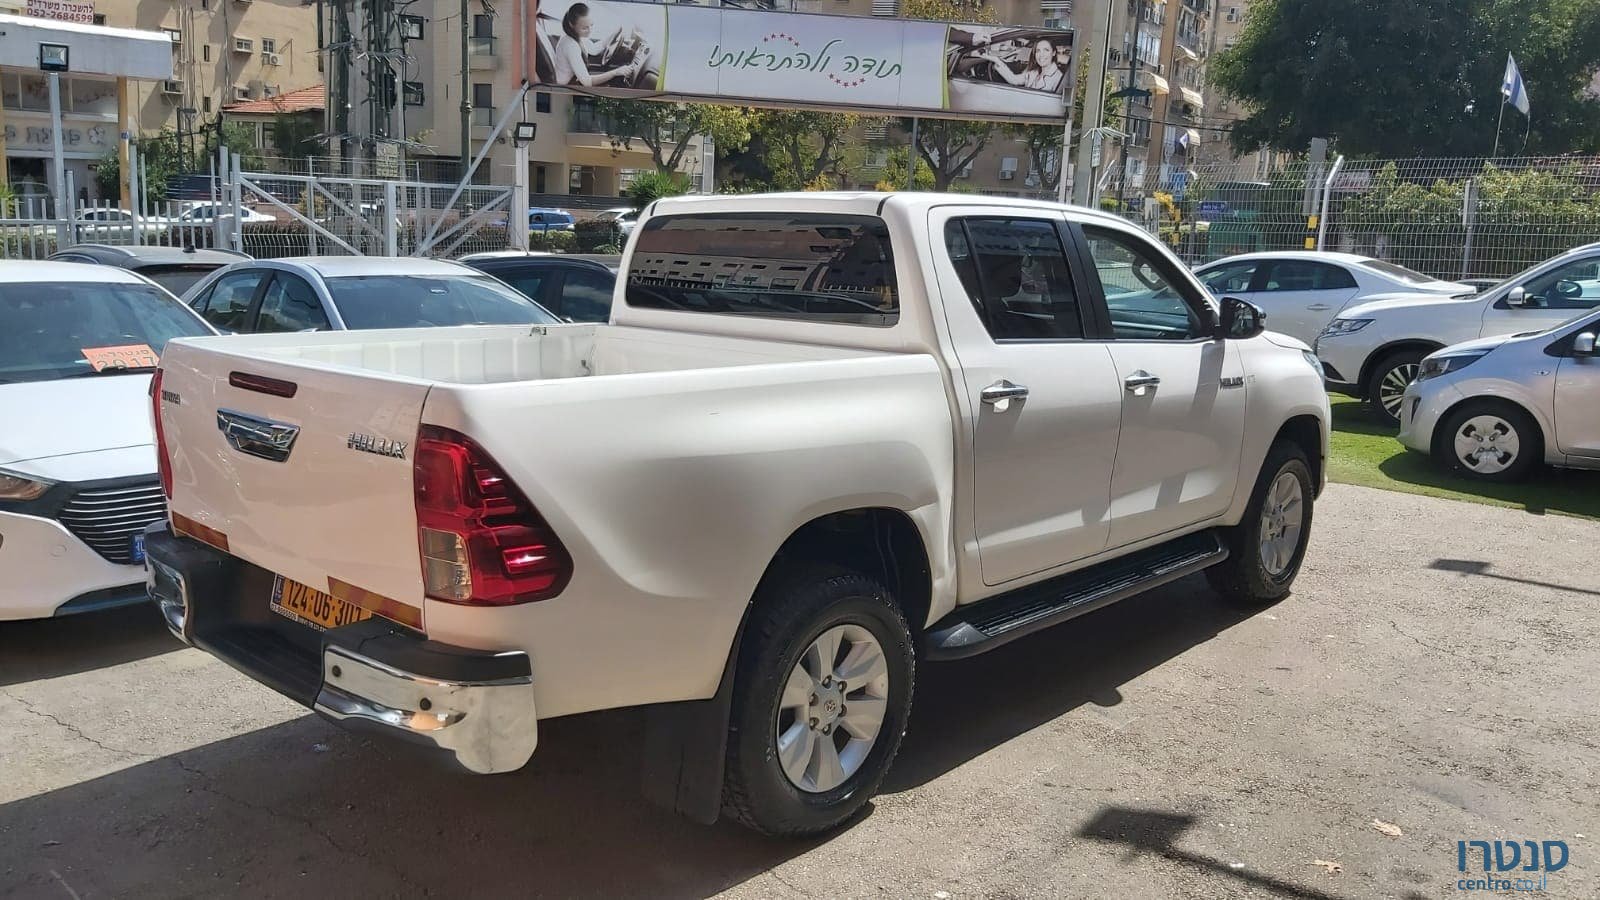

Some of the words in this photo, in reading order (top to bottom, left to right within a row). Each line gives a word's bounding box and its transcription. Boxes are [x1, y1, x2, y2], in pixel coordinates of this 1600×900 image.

[27, 0, 60, 10] משרדים
[62, 3, 94, 13] להשכרה
[26, 8, 93, 22] 052-2684599
[842, 55, 902, 79] תודה
[347, 431, 409, 461] HILUX
